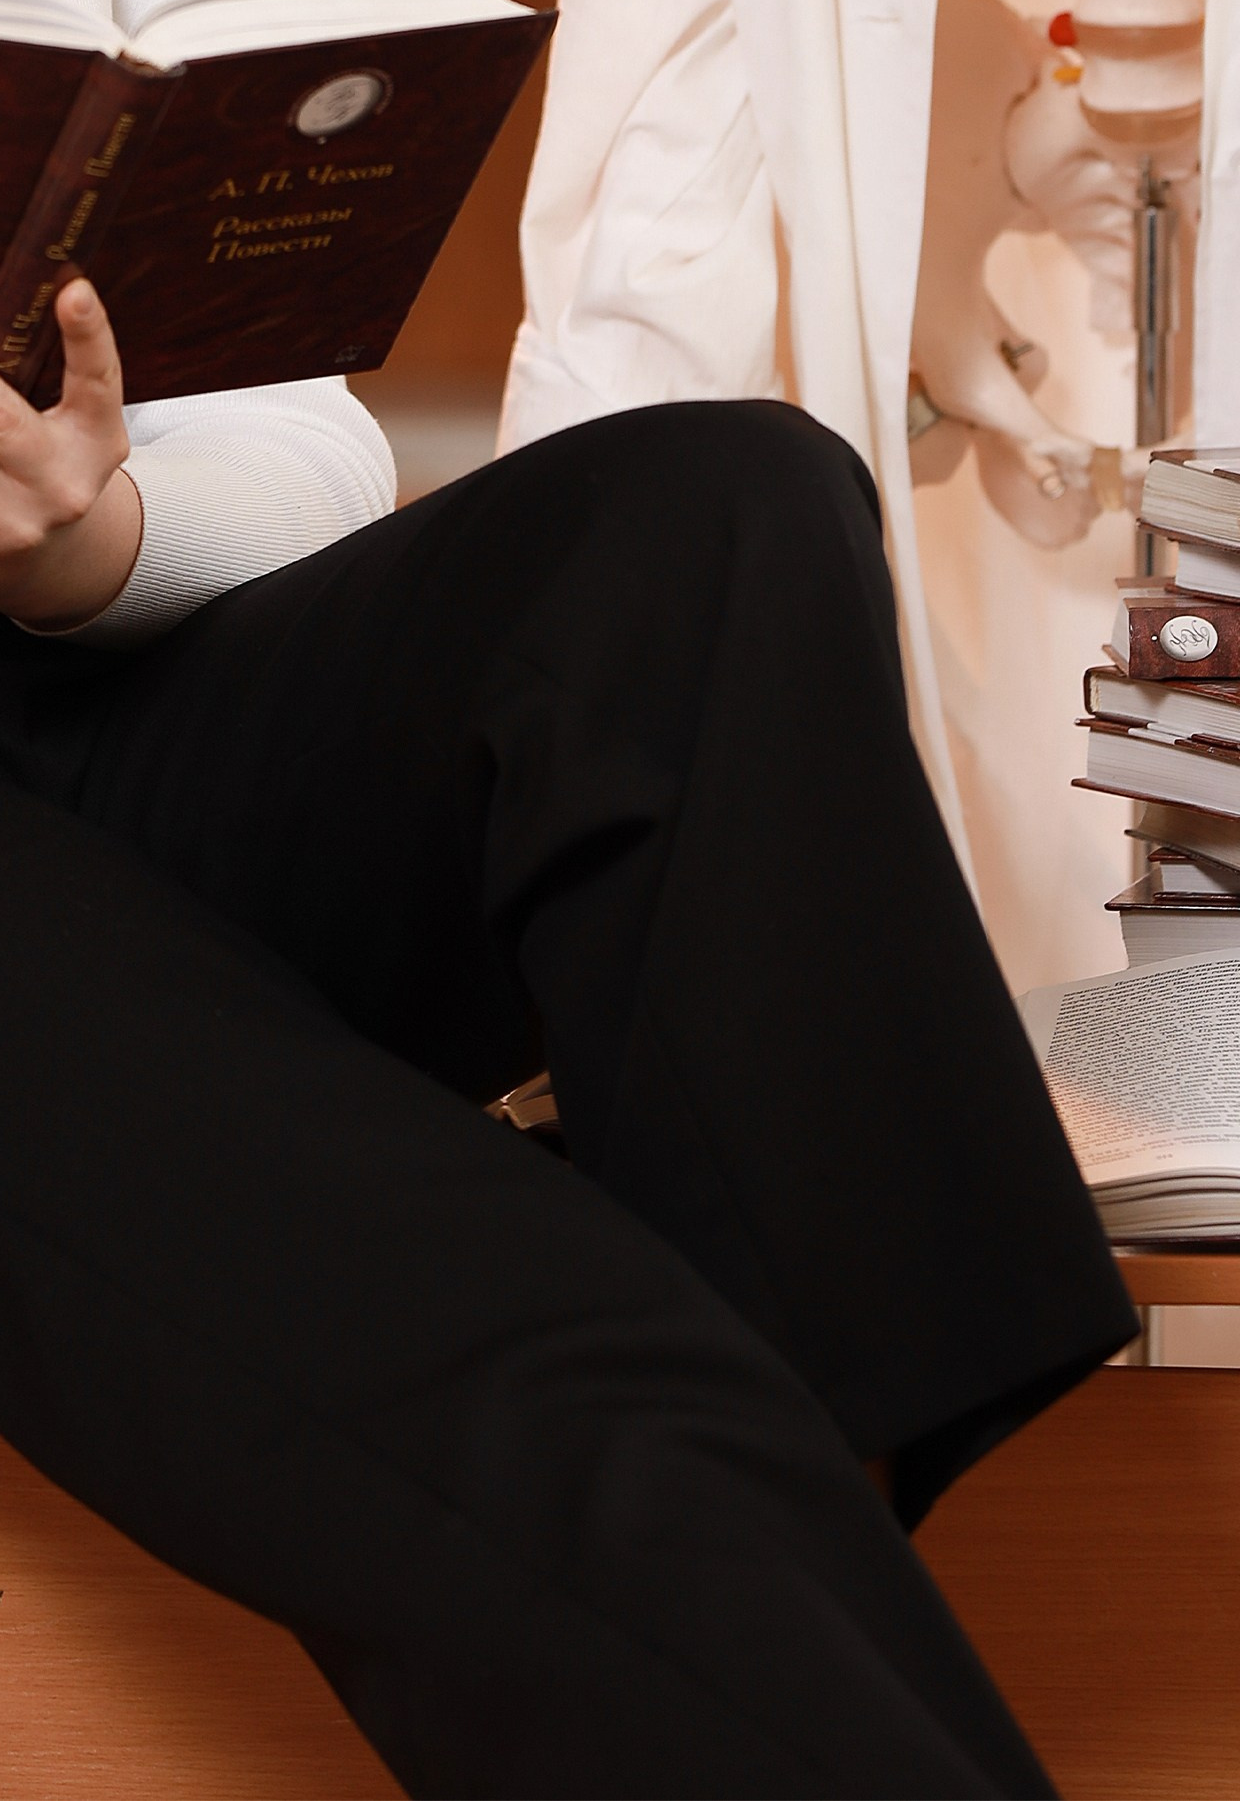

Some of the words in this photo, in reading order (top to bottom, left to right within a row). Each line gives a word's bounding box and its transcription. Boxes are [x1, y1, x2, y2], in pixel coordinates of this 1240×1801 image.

[207, 177, 246, 201] А.
[257, 168, 294, 195] П.
[308, 163, 395, 186] Чехов
[212, 206, 354, 239] Рассказы
[207, 233, 333, 265] Повести
